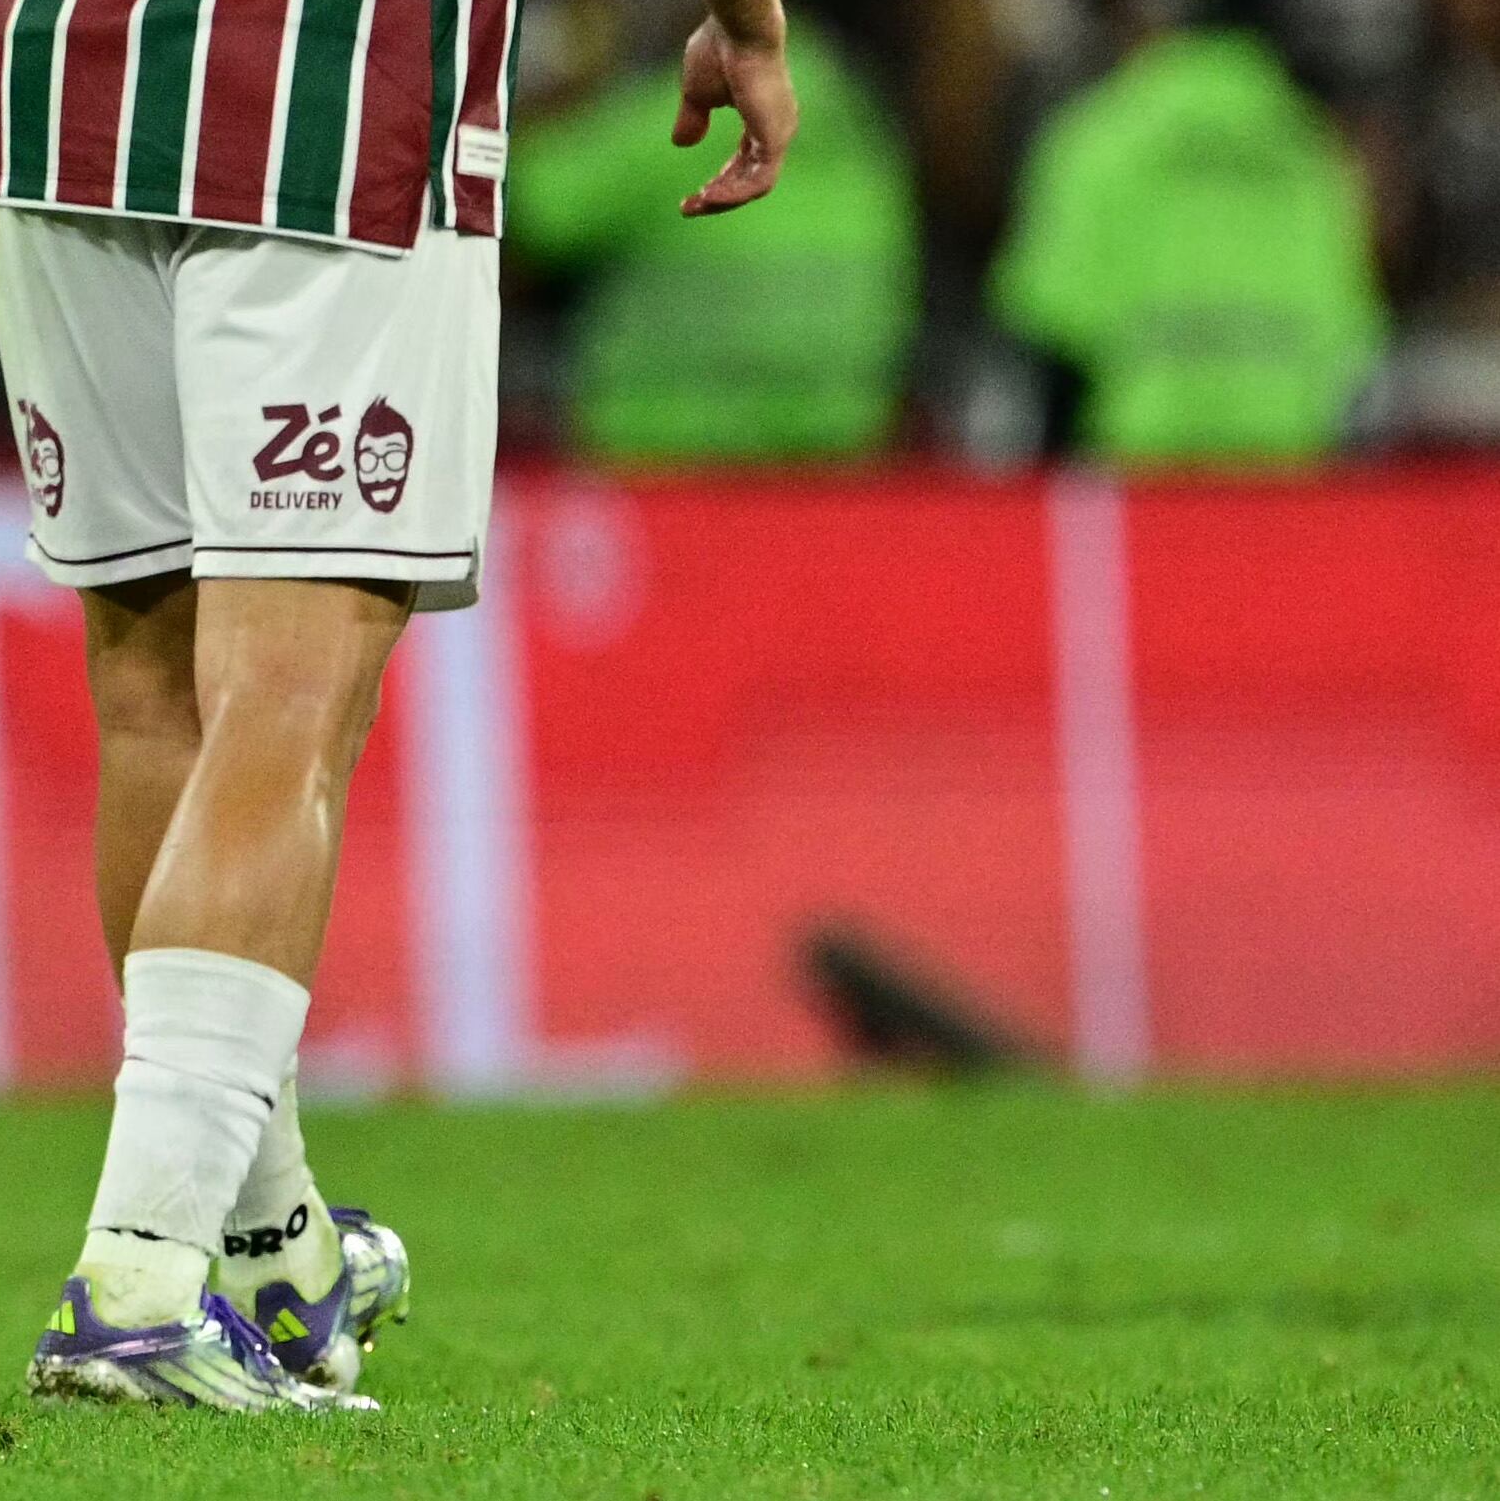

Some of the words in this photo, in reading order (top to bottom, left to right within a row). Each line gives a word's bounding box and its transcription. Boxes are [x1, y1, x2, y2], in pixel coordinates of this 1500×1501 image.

[253, 403, 345, 482] Zé
[250, 491, 343, 510] DELIVERY
[224, 1204, 308, 1257] PRO
